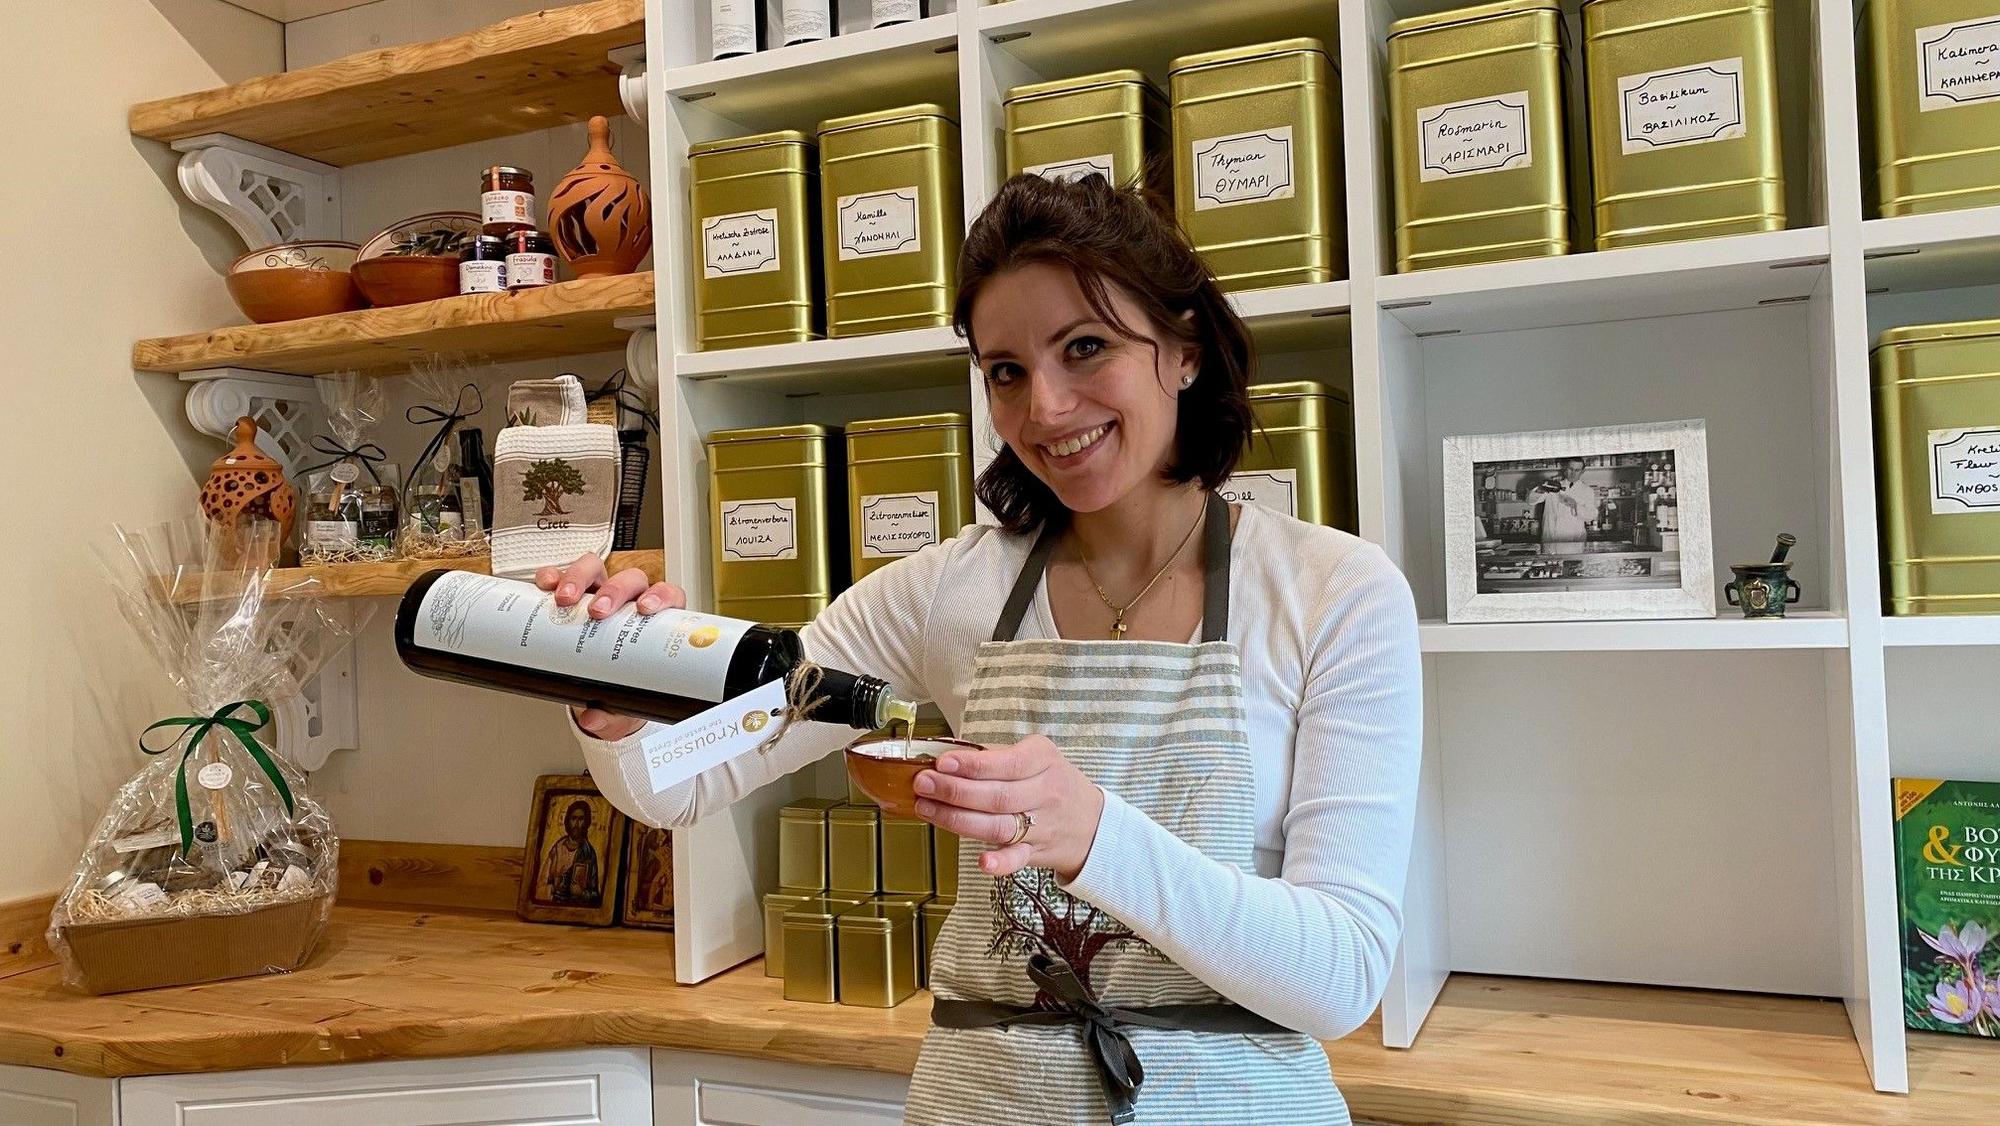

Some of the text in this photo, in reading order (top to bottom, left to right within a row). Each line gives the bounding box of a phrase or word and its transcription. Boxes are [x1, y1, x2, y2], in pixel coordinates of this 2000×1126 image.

[1937, 43, 1998, 61] Kalimera
[1638, 87, 1709, 106] Basilikum
[1437, 120, 1508, 138] Rosmarin
[1211, 153, 1266, 169] Thymian
[1215, 174, 1269, 193] ΘΥΜΑΡΙ
[854, 208, 887, 222] Kamille
[1221, 491, 1256, 502] Dill
[537, 517, 570, 530] Crete
[611, 629, 630, 661] Extra
[651, 721, 740, 770] Kroussos
[1964, 826, 2000, 844] ΒΟ
[1926, 867, 1965, 882] ΤΗΣ
